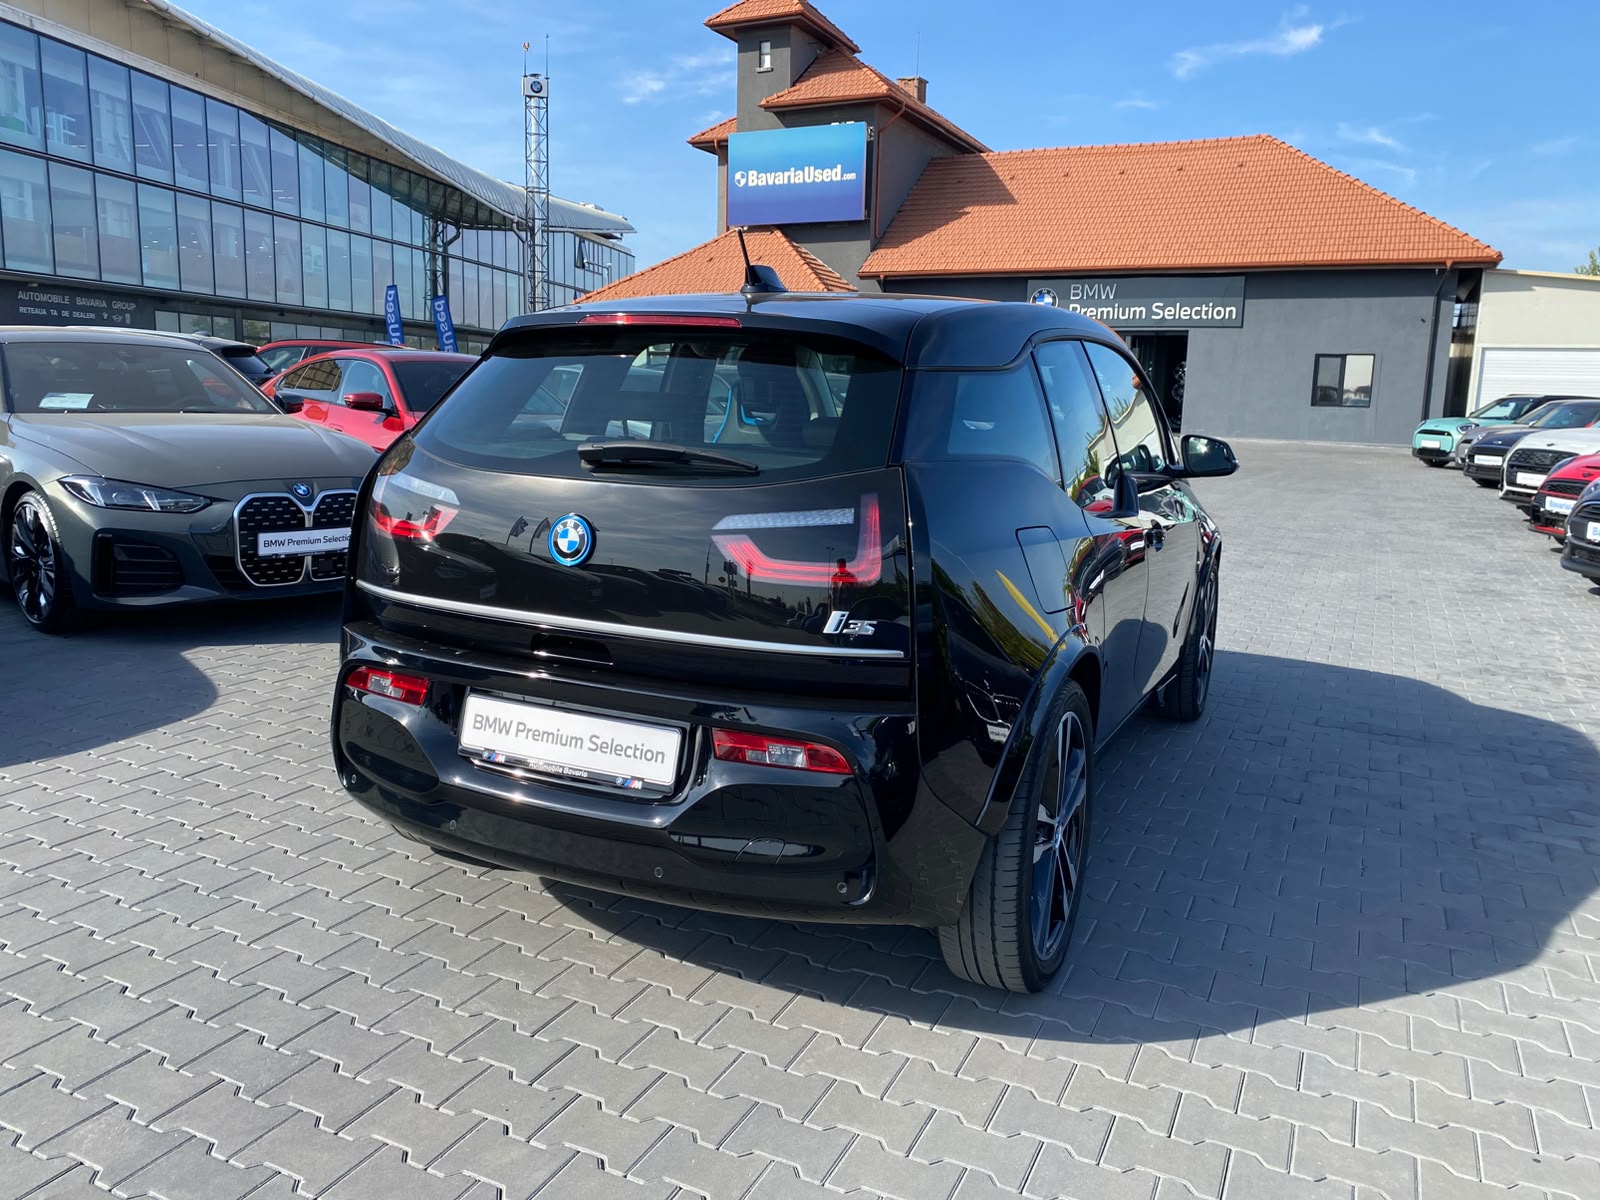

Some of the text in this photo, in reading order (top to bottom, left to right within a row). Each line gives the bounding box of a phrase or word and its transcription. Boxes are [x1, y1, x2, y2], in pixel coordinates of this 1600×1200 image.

[747, 164, 857, 187] BavariaUsed.com
[17, 290, 137, 310] AUTOMOBILE BAVARIA GROUP
[1070, 283, 1117, 300] BMW
[1069, 302, 1236, 320] Premium Selection
[263, 539, 286, 548] BMW
[287, 537, 322, 547] Premium
[472, 713, 665, 764] BMW Premium Selection
[564, 766, 588, 778] Bavaria
